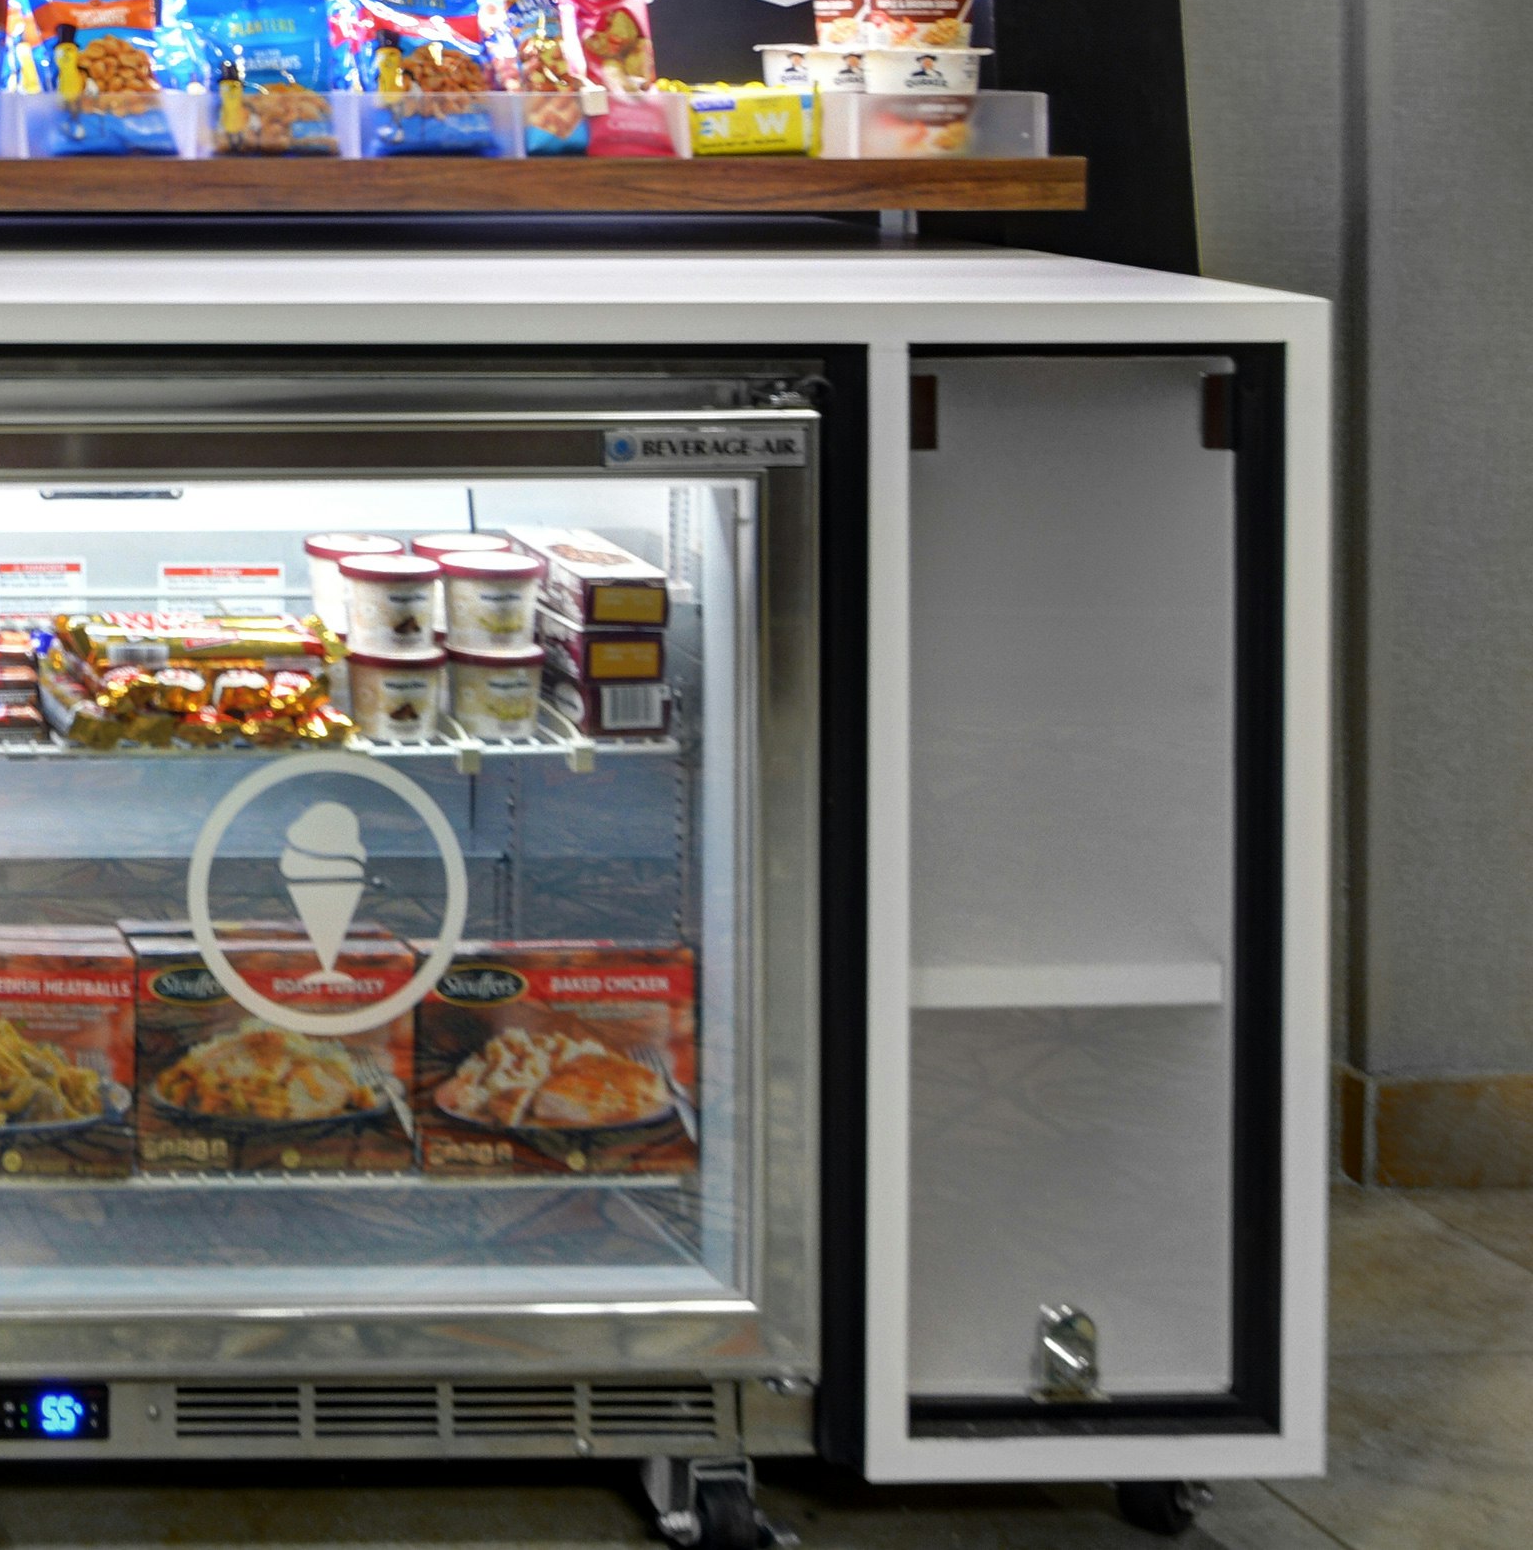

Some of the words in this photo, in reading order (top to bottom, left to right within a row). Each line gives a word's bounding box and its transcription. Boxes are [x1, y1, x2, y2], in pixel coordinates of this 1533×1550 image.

[43, 978, 131, 997] MEATBALLS
[550, 976, 600, 992] BAKED
[603, 976, 669, 992] CHICKEN
